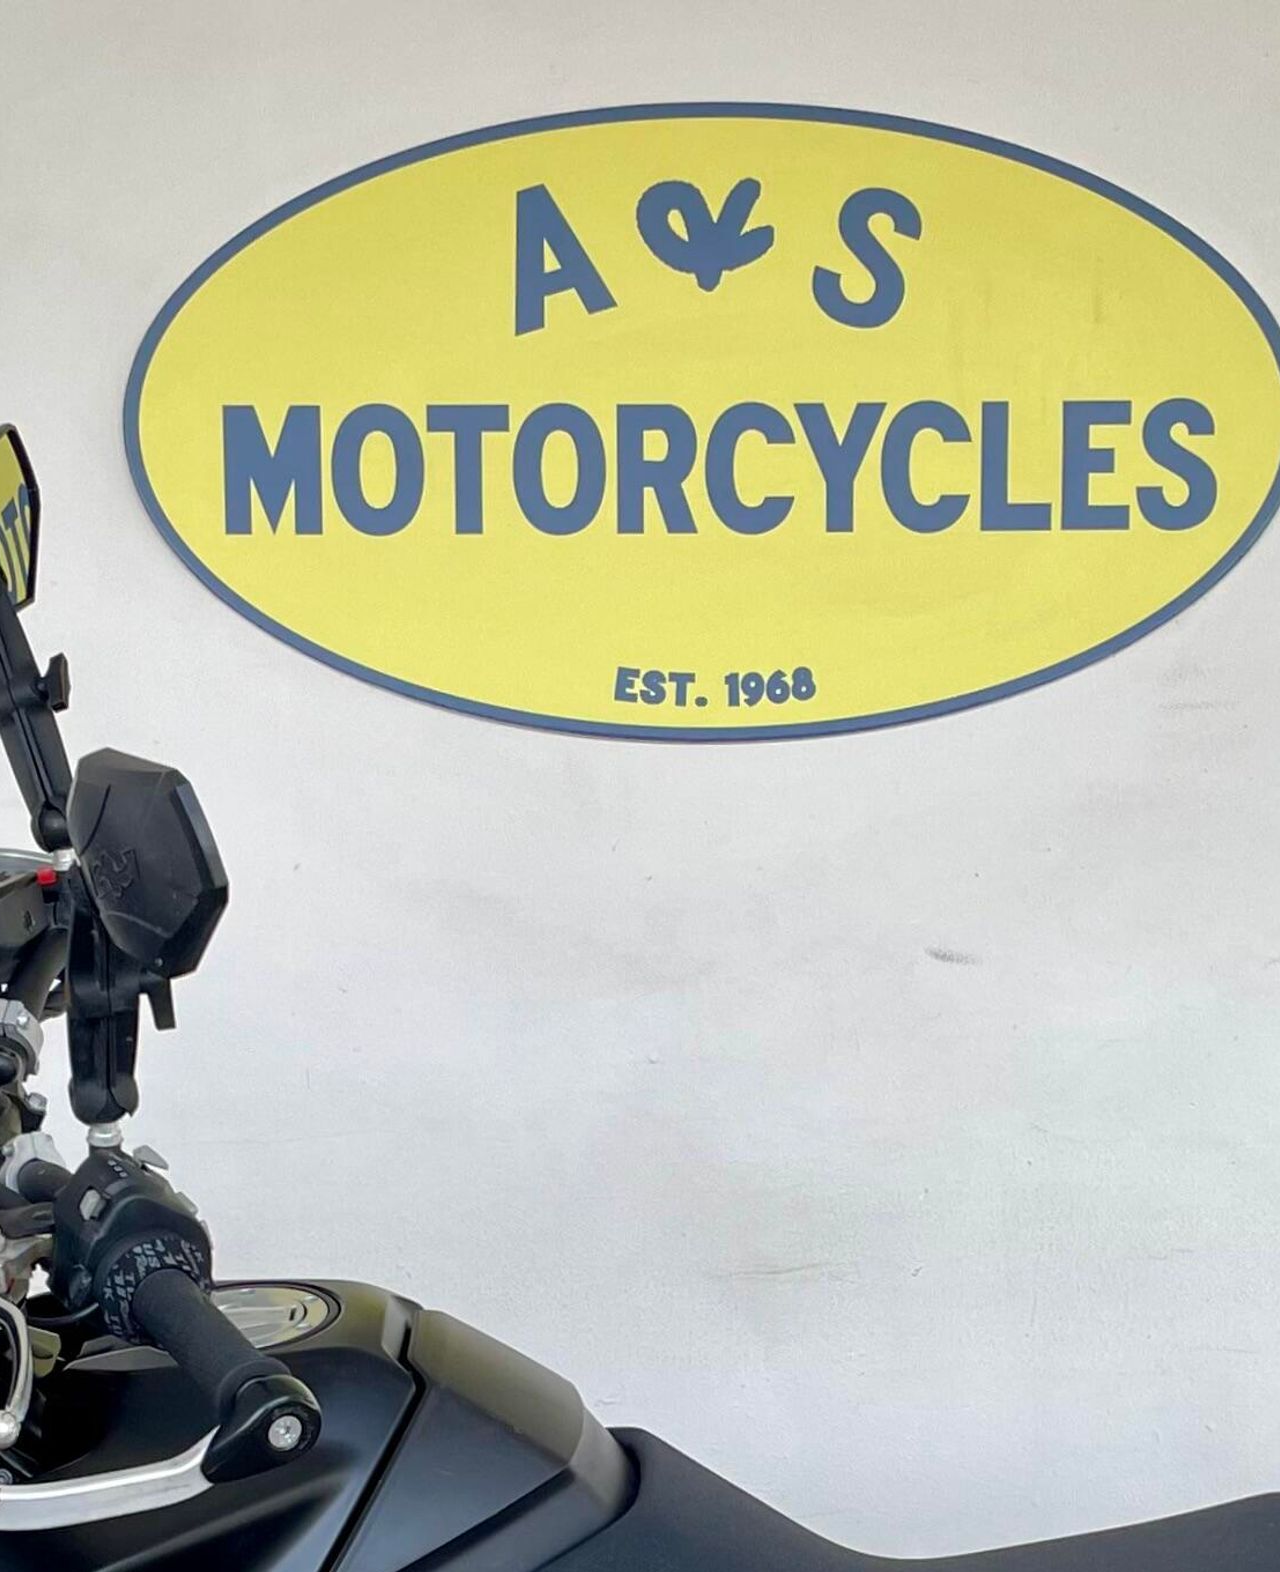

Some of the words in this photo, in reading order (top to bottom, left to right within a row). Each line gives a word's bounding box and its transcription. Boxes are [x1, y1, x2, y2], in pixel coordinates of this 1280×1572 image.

[514, 183, 618, 337] A
[812, 186, 923, 330] S
[220, 397, 1218, 537] MOTORCYCLES
[613, 666, 709, 708] EST.
[723, 665, 817, 708] 1968
